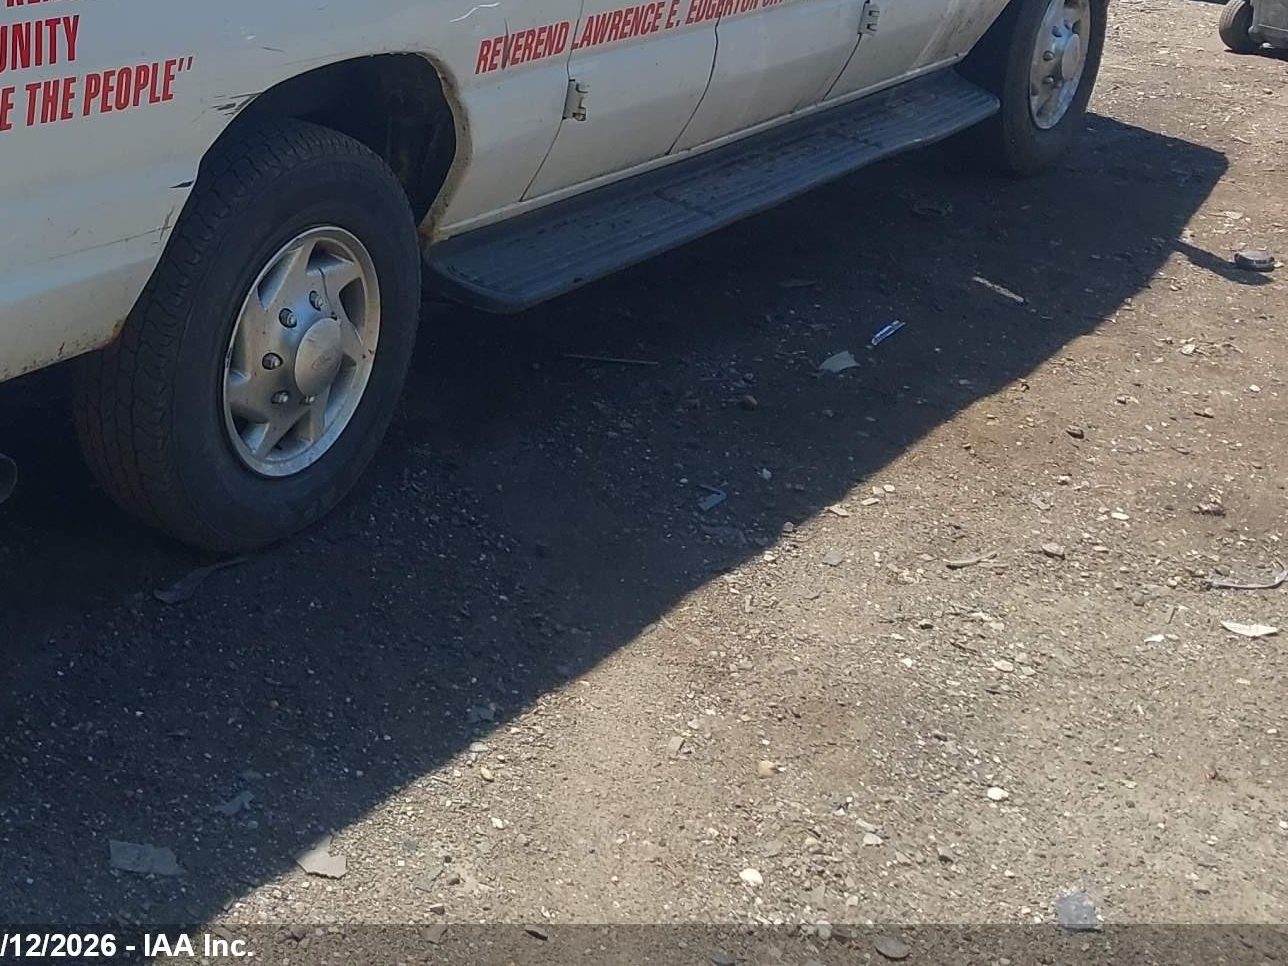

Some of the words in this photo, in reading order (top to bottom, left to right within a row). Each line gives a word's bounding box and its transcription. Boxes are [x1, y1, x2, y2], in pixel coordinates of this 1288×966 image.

[476, 21, 570, 74] REVEREND
[570, 2, 665, 50] LAWRENCE
[666, 0, 681, 28] E.
[25, 77, 76, 126] THE
